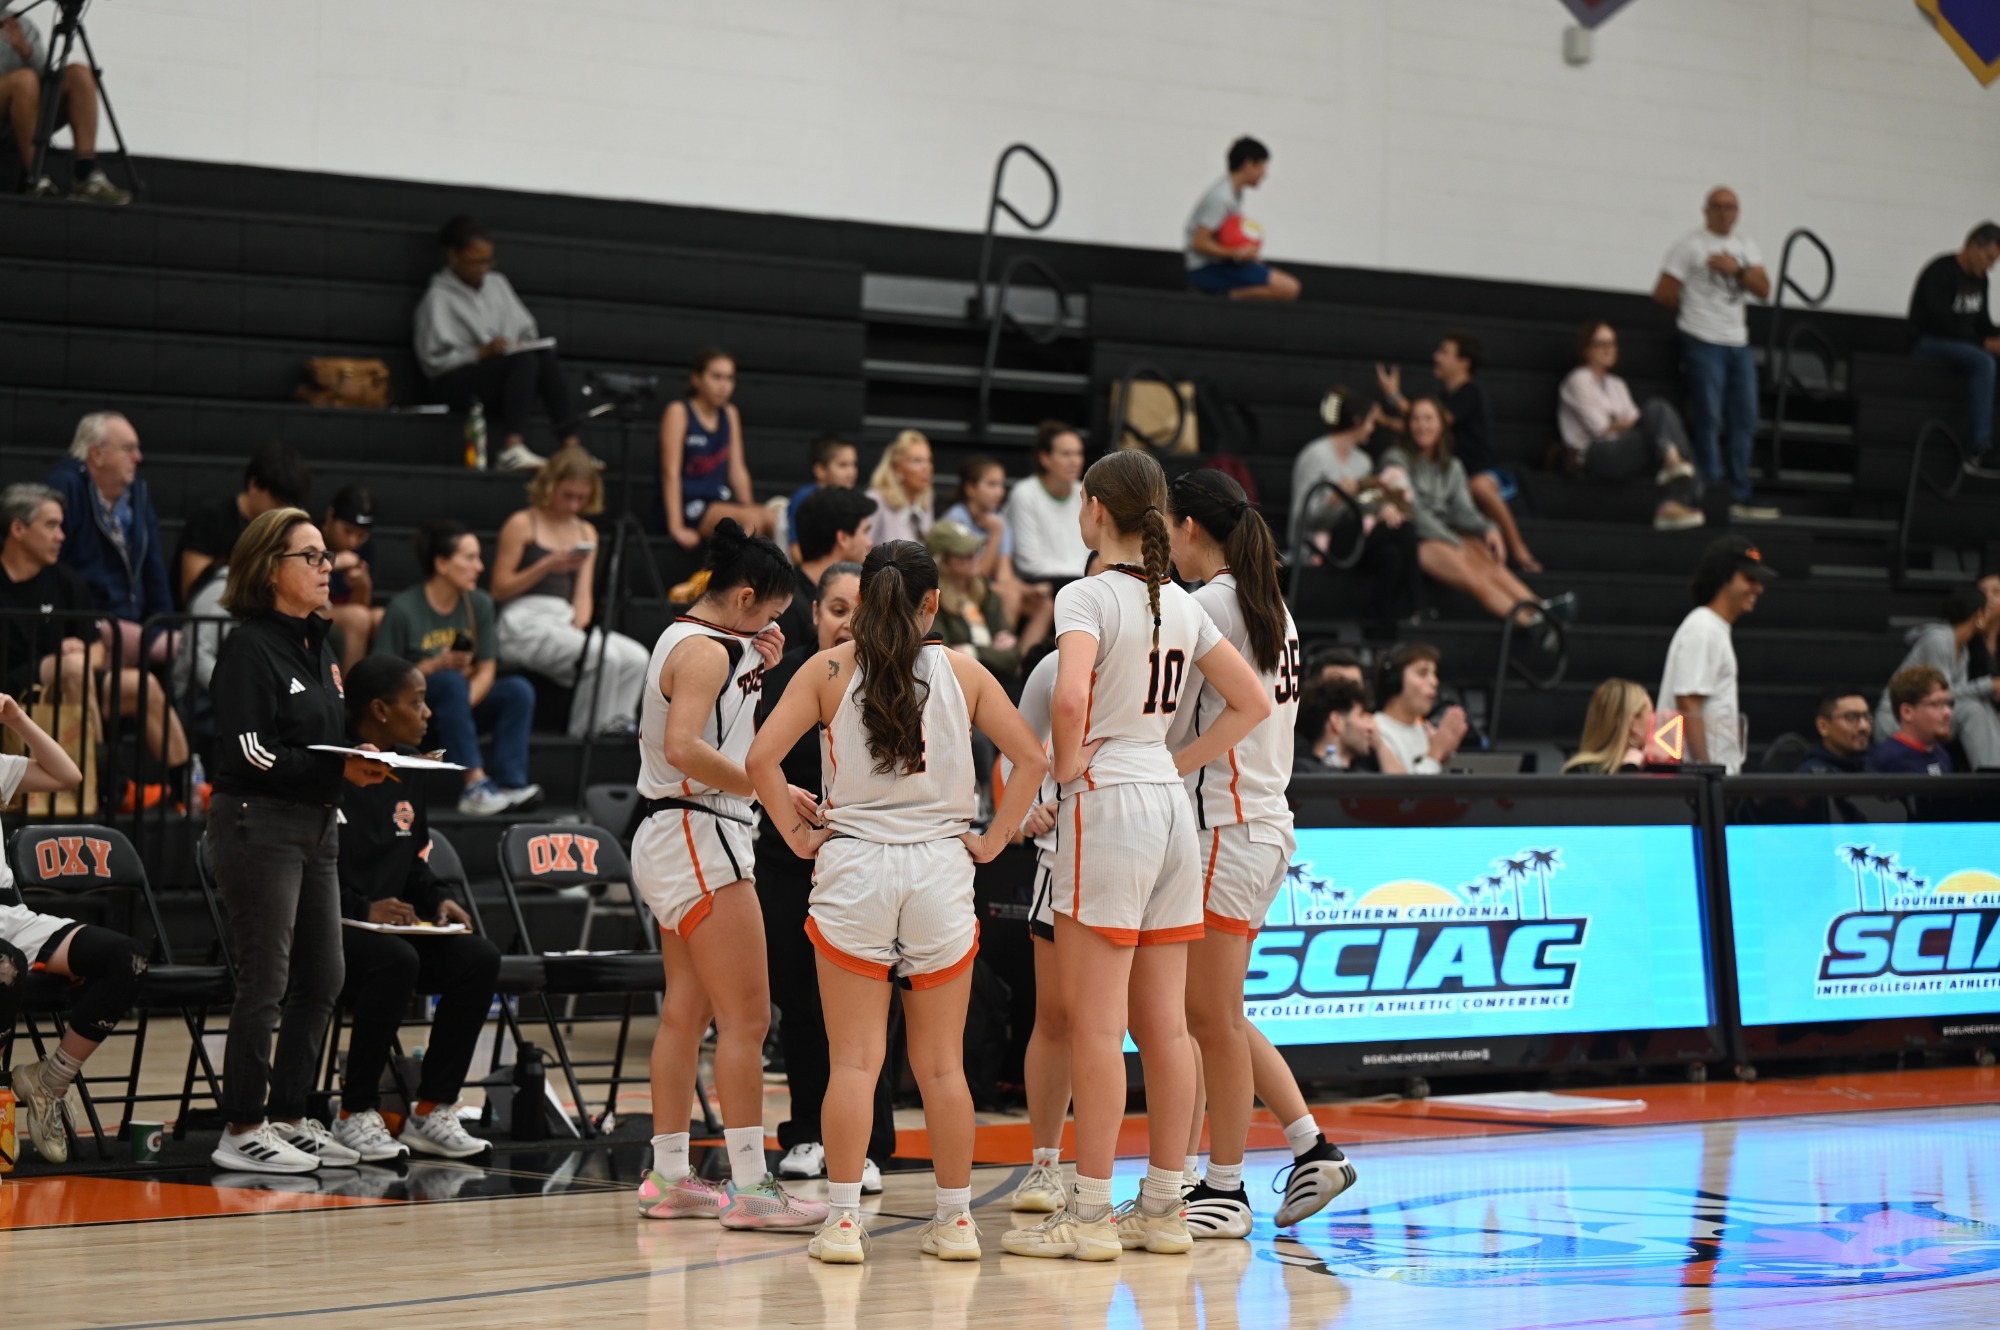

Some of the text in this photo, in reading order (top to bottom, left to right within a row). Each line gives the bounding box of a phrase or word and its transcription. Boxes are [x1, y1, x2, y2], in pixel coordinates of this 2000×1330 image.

[1142, 648, 1185, 715] 10
[1274, 638, 1300, 705] 35
[35, 836, 112, 880] OXY
[527, 833, 599, 875] OXY
[1305, 905, 1510, 920] SOUTHERN CALIFORNIA
[1894, 895, 1965, 906] SOUTHERN
[1243, 921, 1580, 996] SCIAC
[1826, 912, 2000, 976] SCI
[1246, 995, 1571, 1018] RCOLLEGIATE ATHLETIC CONFERENCE
[1817, 980, 1942, 995] INTERCOLLEGIATE
